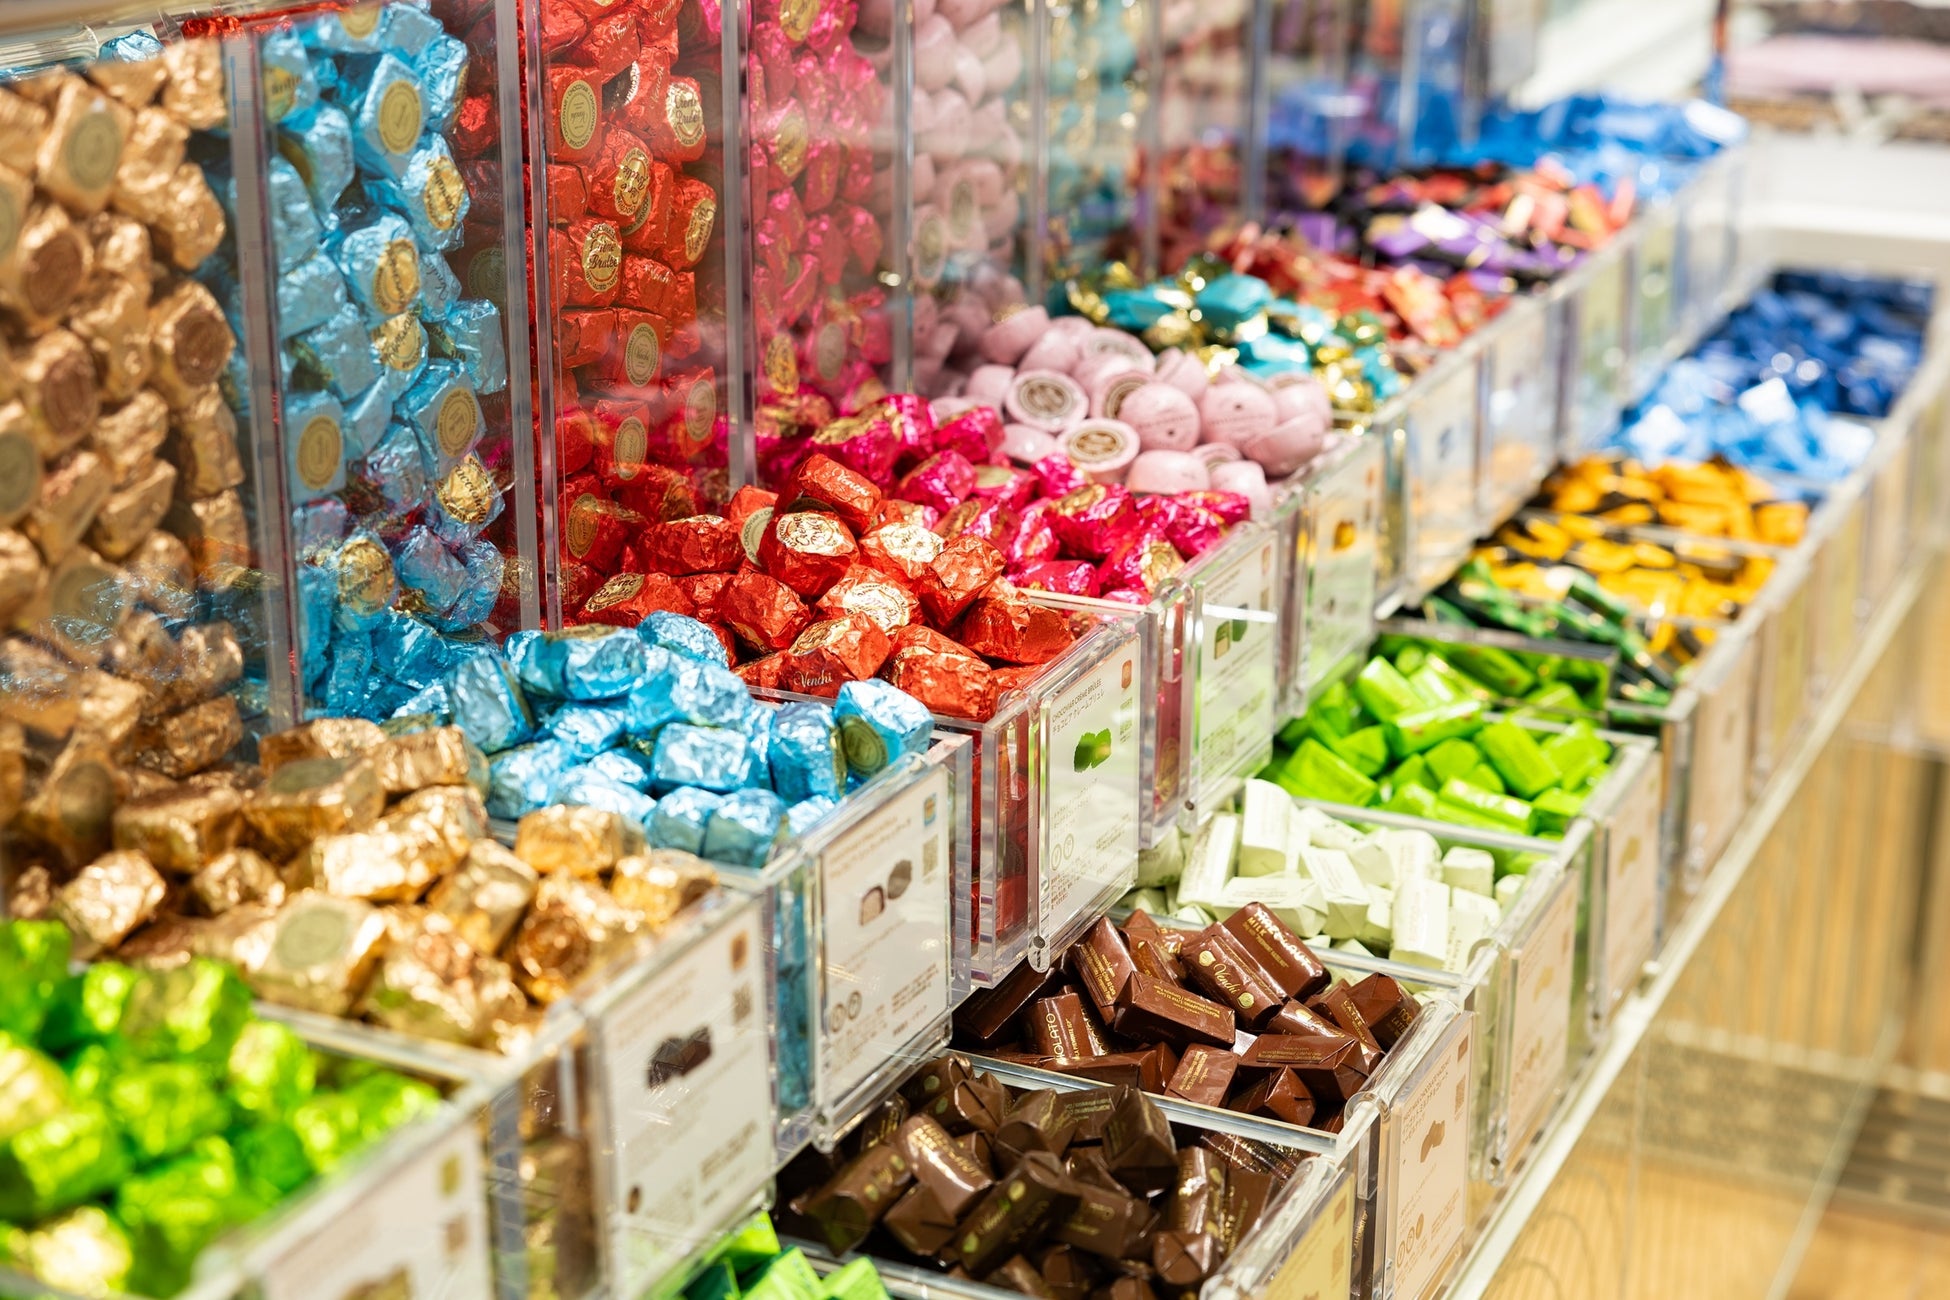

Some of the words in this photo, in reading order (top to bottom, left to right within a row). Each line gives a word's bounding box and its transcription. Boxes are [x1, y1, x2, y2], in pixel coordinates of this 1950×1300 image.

[793, 669, 833, 688] Venchi
[1246, 917, 1267, 937] MILK
[1212, 962, 1241, 995] Venchi
[1342, 999, 1363, 1027] LATTE
